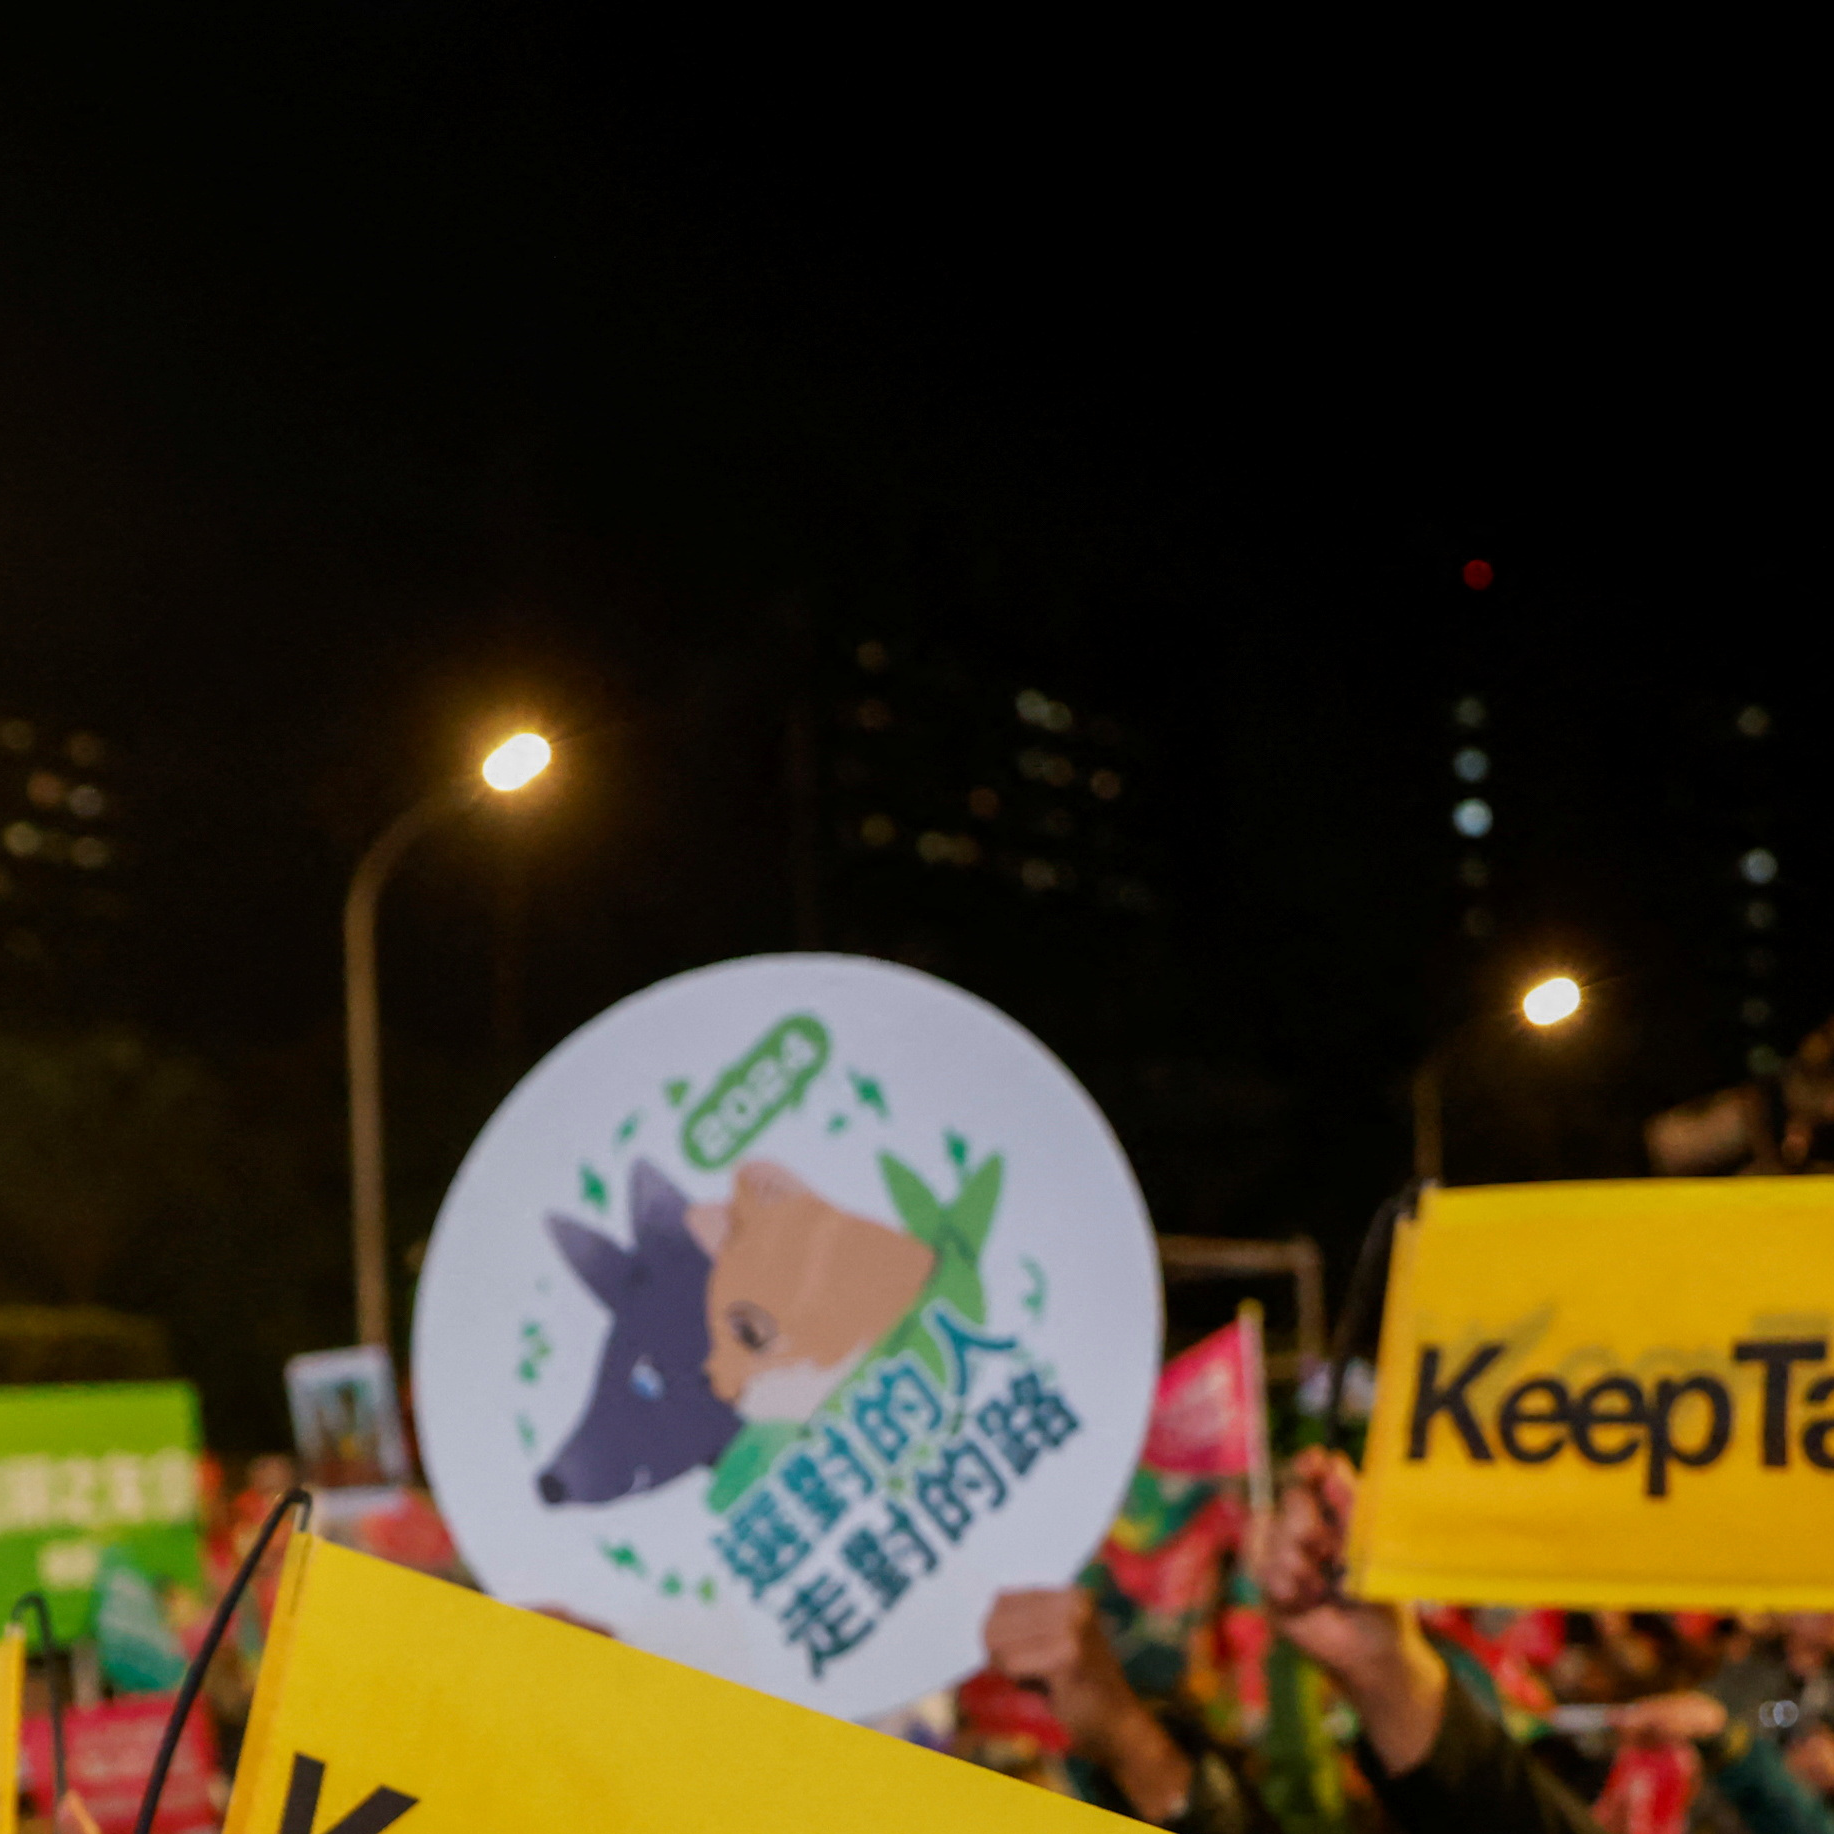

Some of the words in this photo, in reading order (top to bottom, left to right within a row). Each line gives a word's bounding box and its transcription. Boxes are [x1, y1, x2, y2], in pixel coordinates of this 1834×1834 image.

[711, 1306, 1019, 1602] 選對的人
[779, 1366, 1084, 1680] 走對的路
